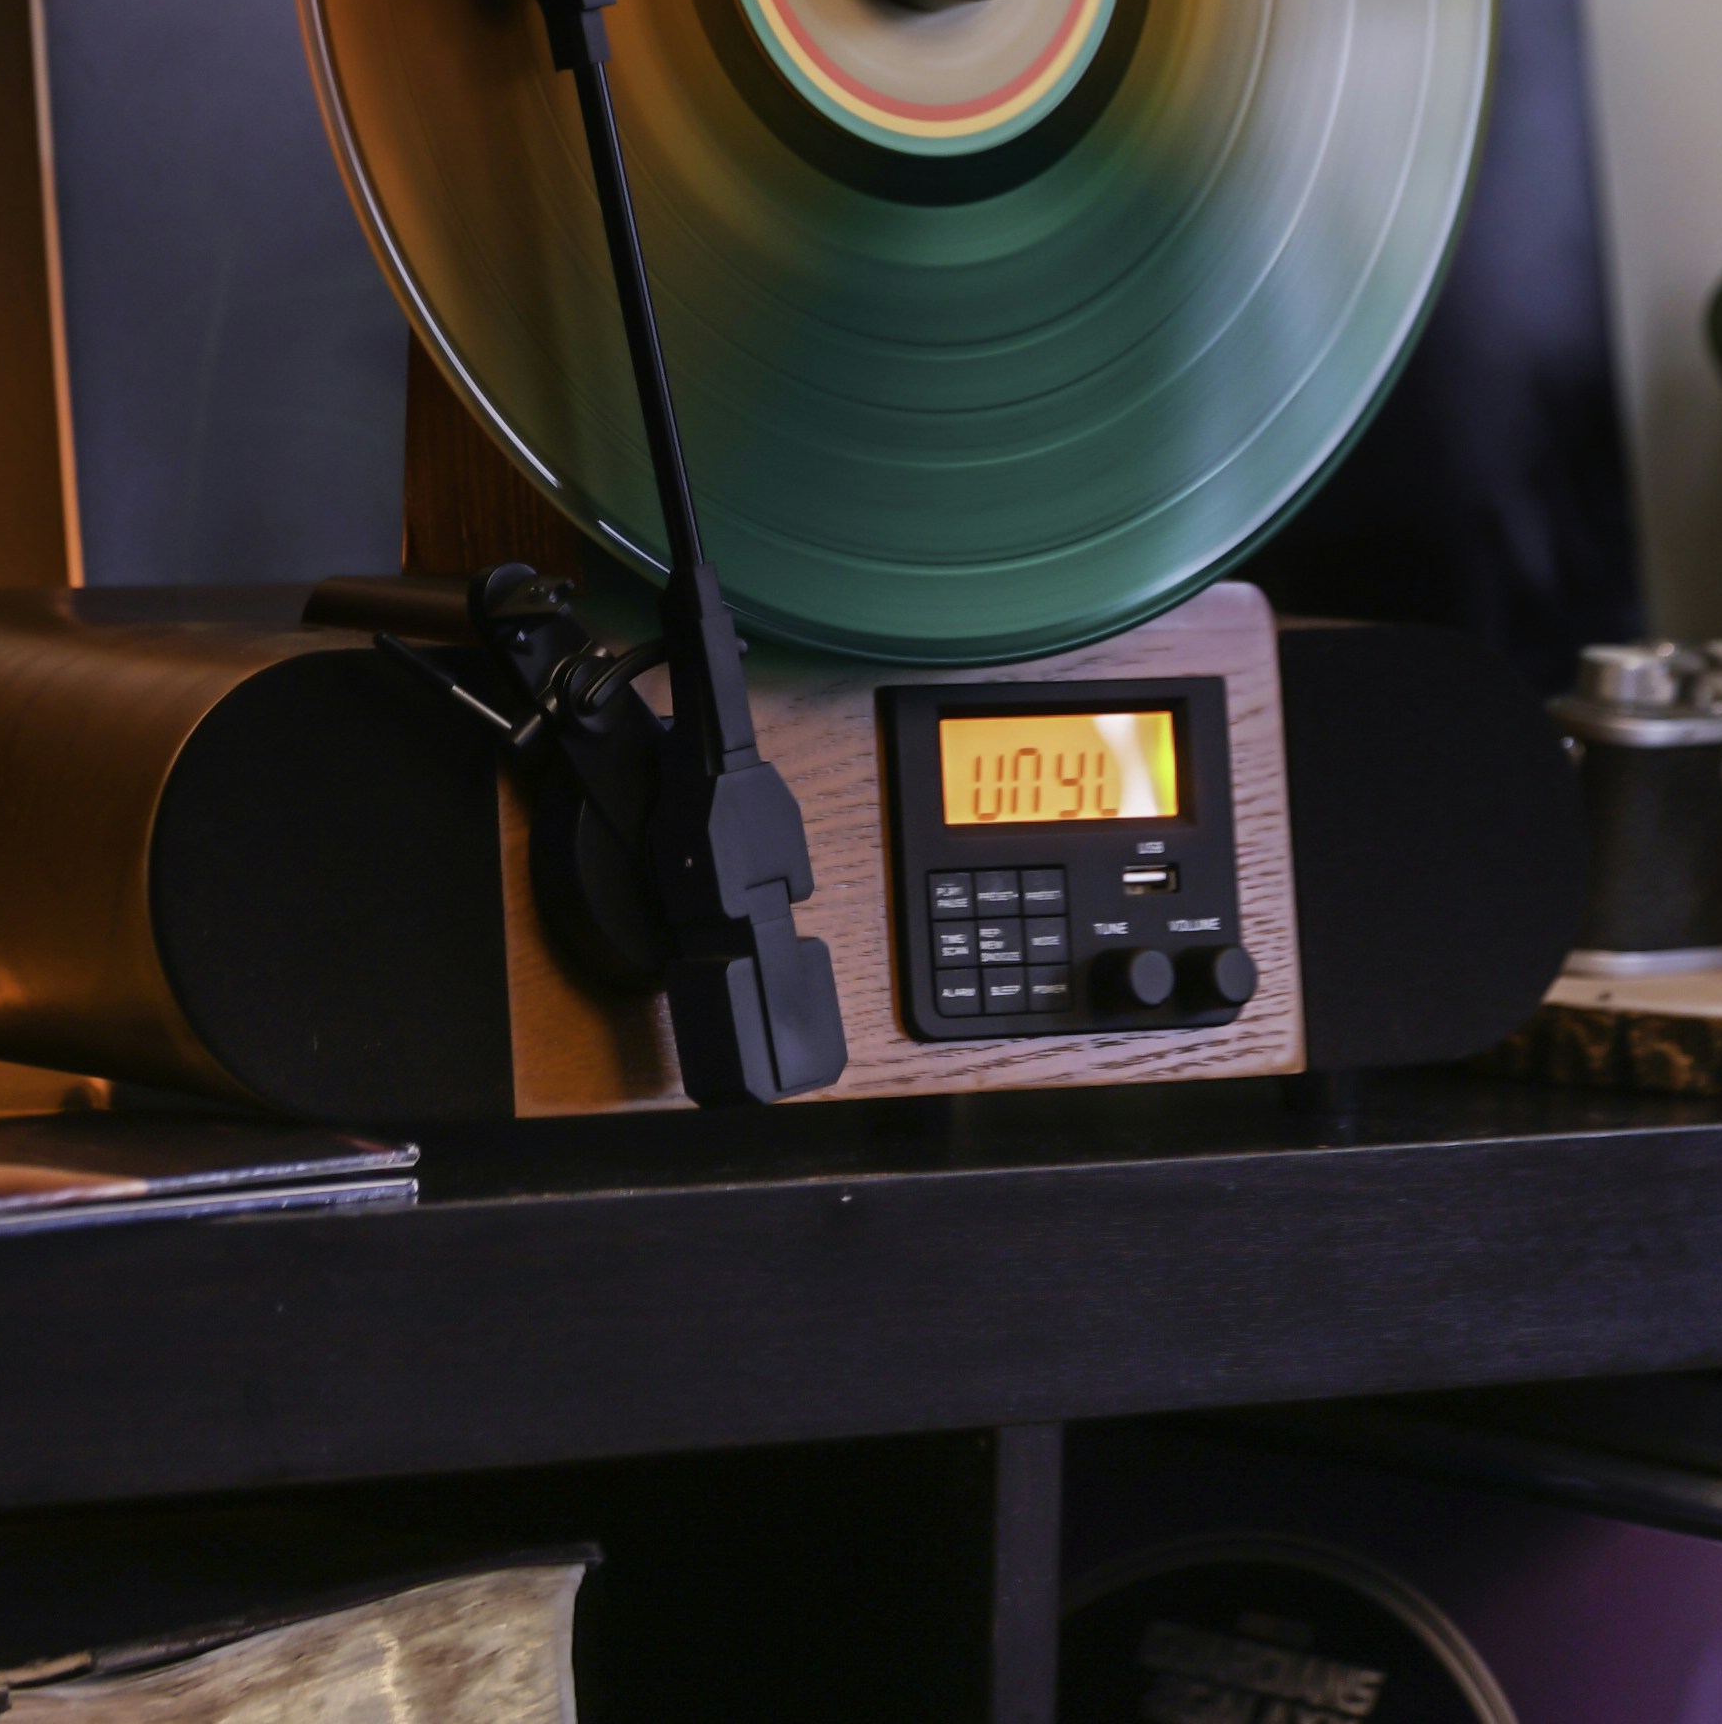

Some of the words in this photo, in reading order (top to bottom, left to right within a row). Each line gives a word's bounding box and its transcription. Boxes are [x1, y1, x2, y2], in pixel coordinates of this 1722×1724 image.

[1137, 841, 1165, 854] USB
[1093, 922, 1129, 935] TUNE
[1167, 917, 1221, 932] VOLUME
